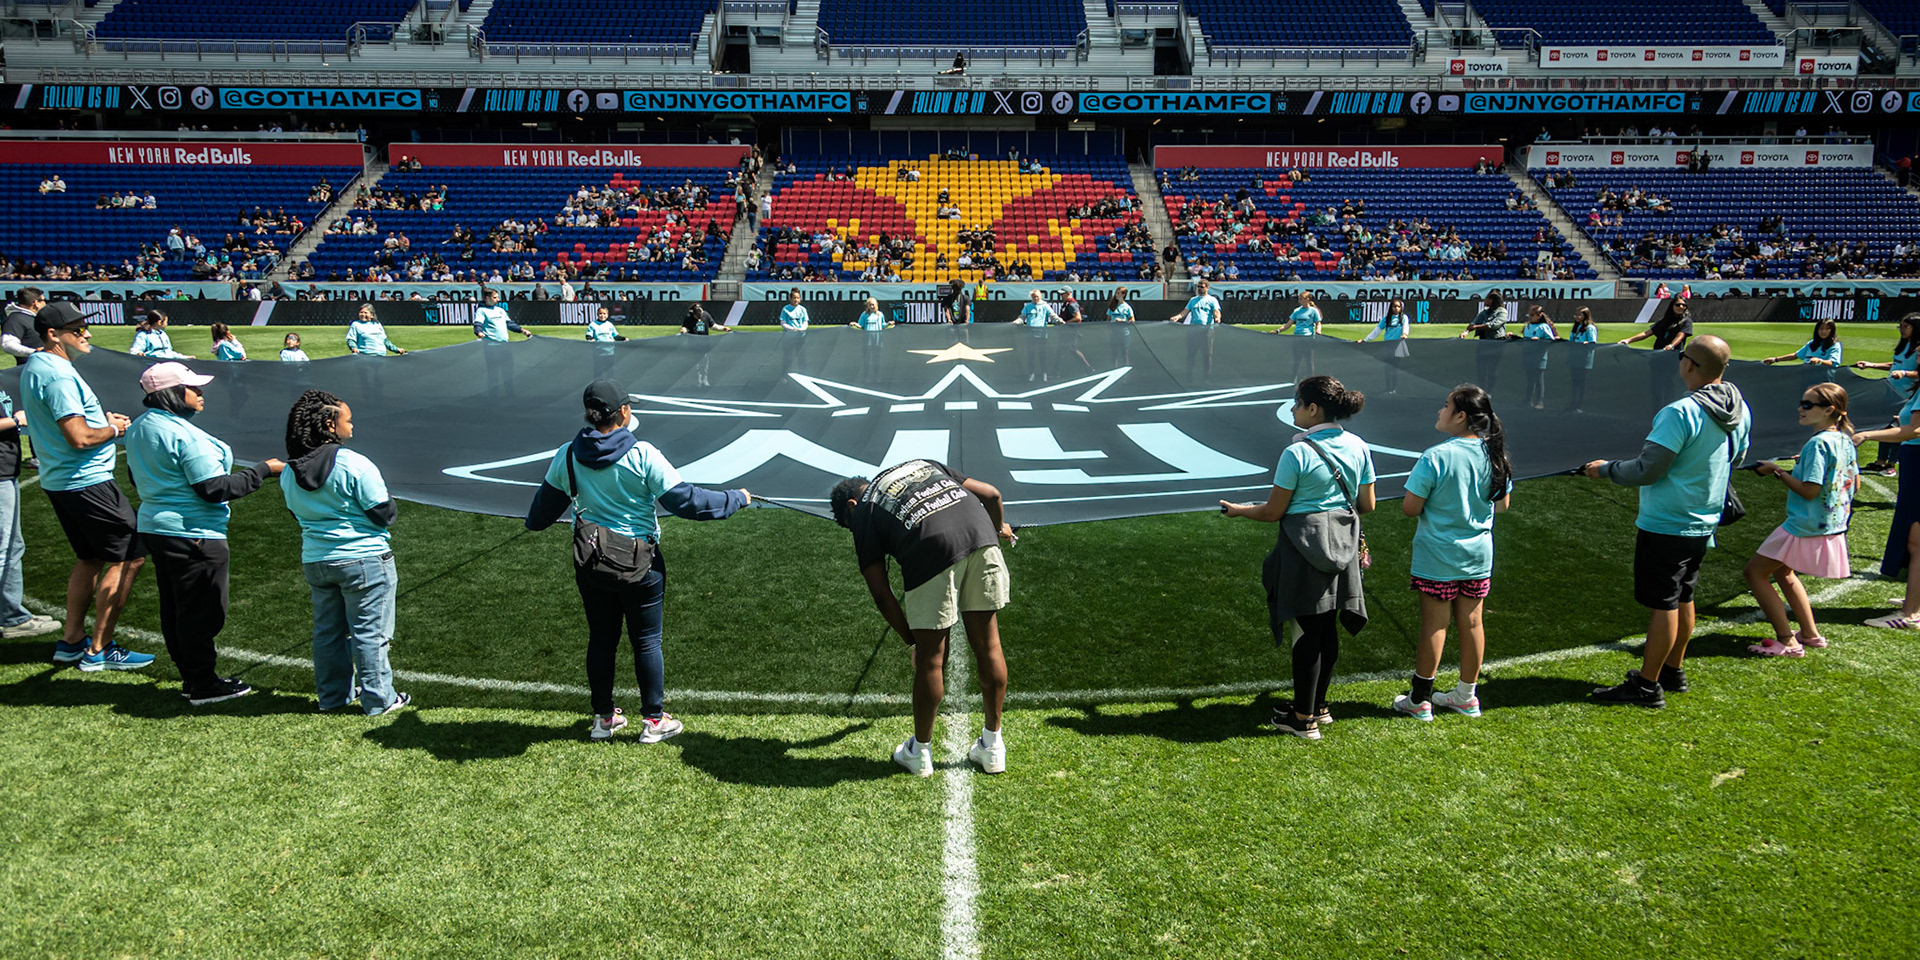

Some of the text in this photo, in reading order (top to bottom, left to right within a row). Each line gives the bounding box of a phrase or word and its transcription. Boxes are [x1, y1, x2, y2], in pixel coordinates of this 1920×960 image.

[1467, 63, 1503, 71] TOYOTA
[1817, 62, 1852, 71] TOYOTA
[43, 86, 120, 108] FOLLOW US ON
[225, 90, 417, 108] @GOTHAMFC
[484, 90, 560, 111] FOLLOW US ON
[629, 93, 848, 110] @NJNYGOTHAMFC
[912, 91, 986, 113] FOLLOW US ON
[1083, 94, 1267, 111] @GOTHAMFC
[1330, 92, 1404, 113] FOLLOW US ON
[1469, 94, 1682, 111] @NJNYGOTHAMFC
[1743, 91, 1817, 113] FOLLOW US ON
[108, 147, 252, 164] NEW YORK Red Bulls
[504, 150, 642, 167] NEW YORK Red Bulls
[1266, 151, 1399, 167] NEW YORK Red Bulls
[1562, 154, 1595, 162] TOYOTA
[1627, 154, 1660, 162] TOYOTA
[1757, 154, 1789, 162] TOYOTA
[1822, 154, 1854, 162] TOYOTA
[80, 302, 125, 324] HOUSTON
[1416, 301, 1429, 322] VS
[1843, 300, 1855, 320] FC
[1866, 298, 1880, 320] VS
[914, 482, 942, 500] Football
[904, 488, 968, 530] Chelsea Football Club
